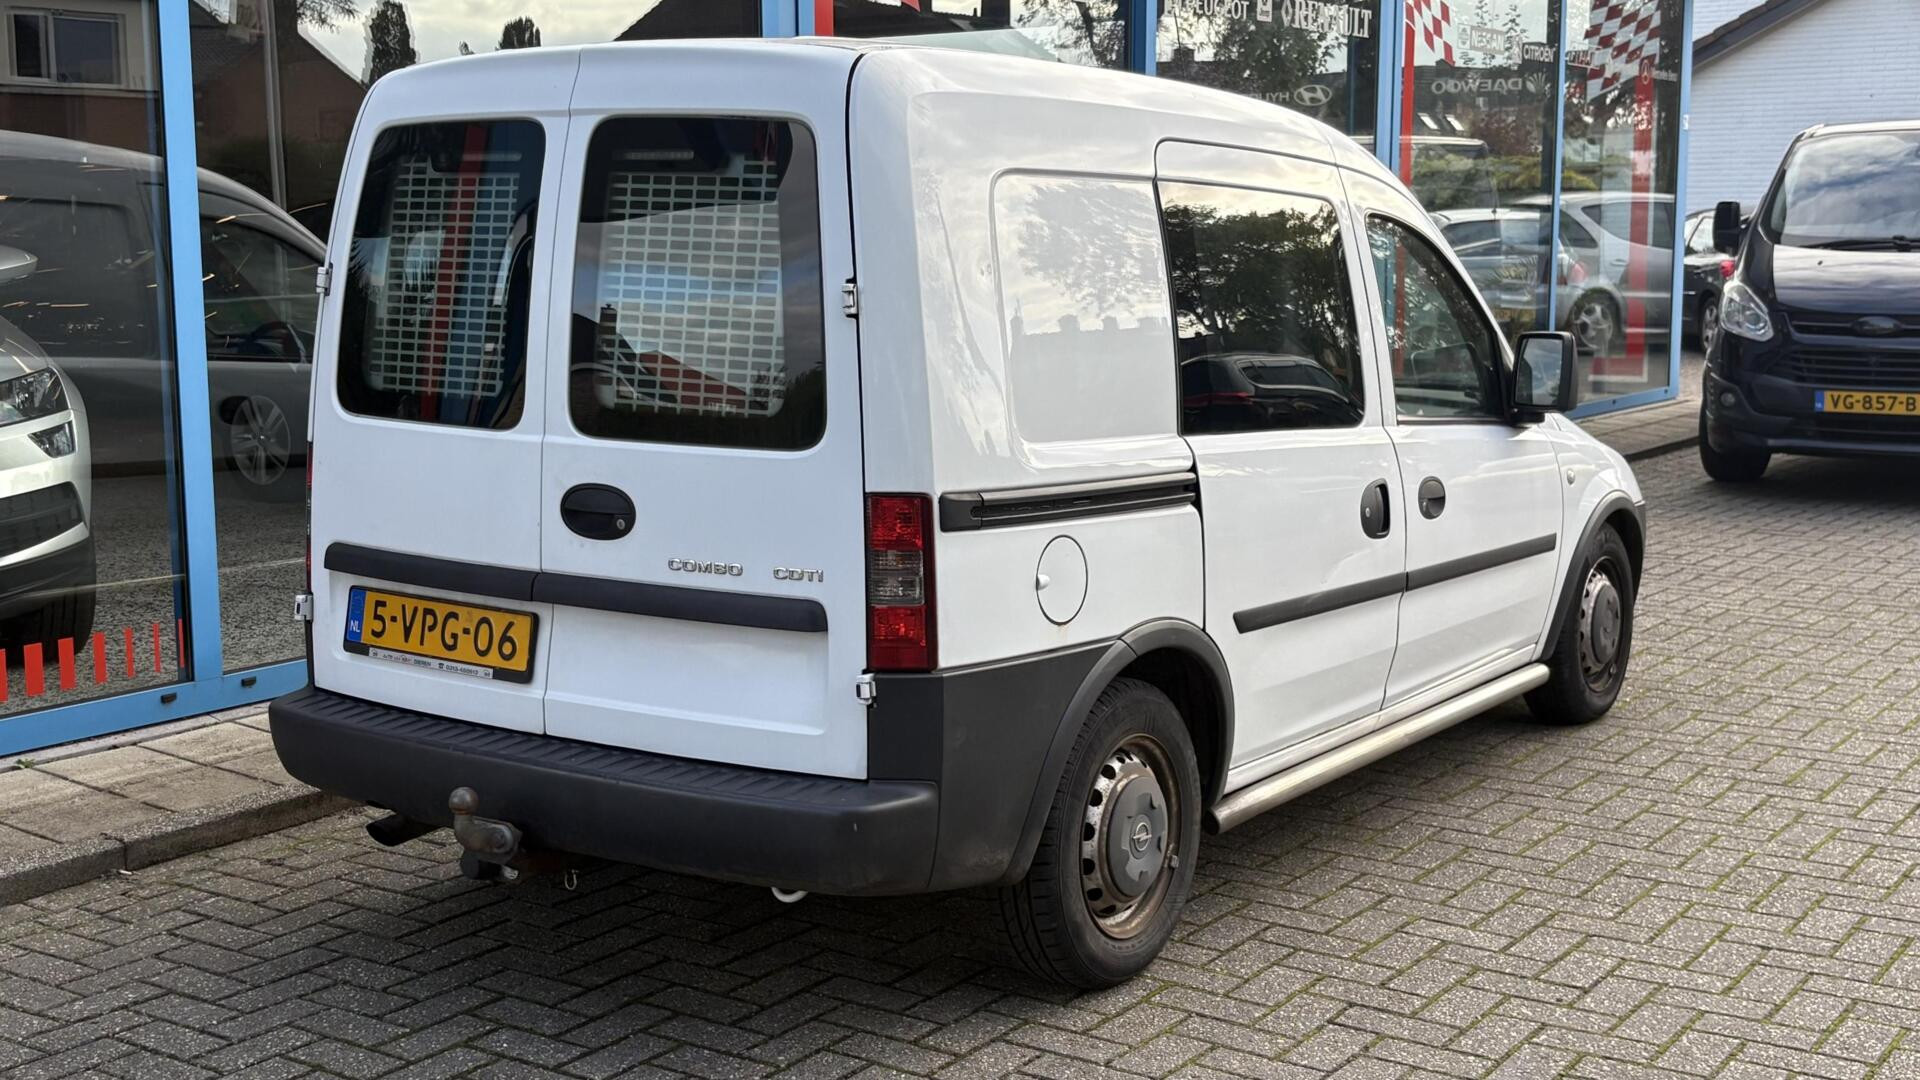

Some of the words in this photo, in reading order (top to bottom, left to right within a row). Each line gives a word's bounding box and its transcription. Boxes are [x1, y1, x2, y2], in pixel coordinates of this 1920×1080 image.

[1291, 0, 1373, 38] RENAULT
[1830, 394, 1917, 412] VG-857-B
[668, 558, 743, 576] COMBO
[350, 620, 361, 633] NL
[370, 600, 518, 662] 5-VPG-06
